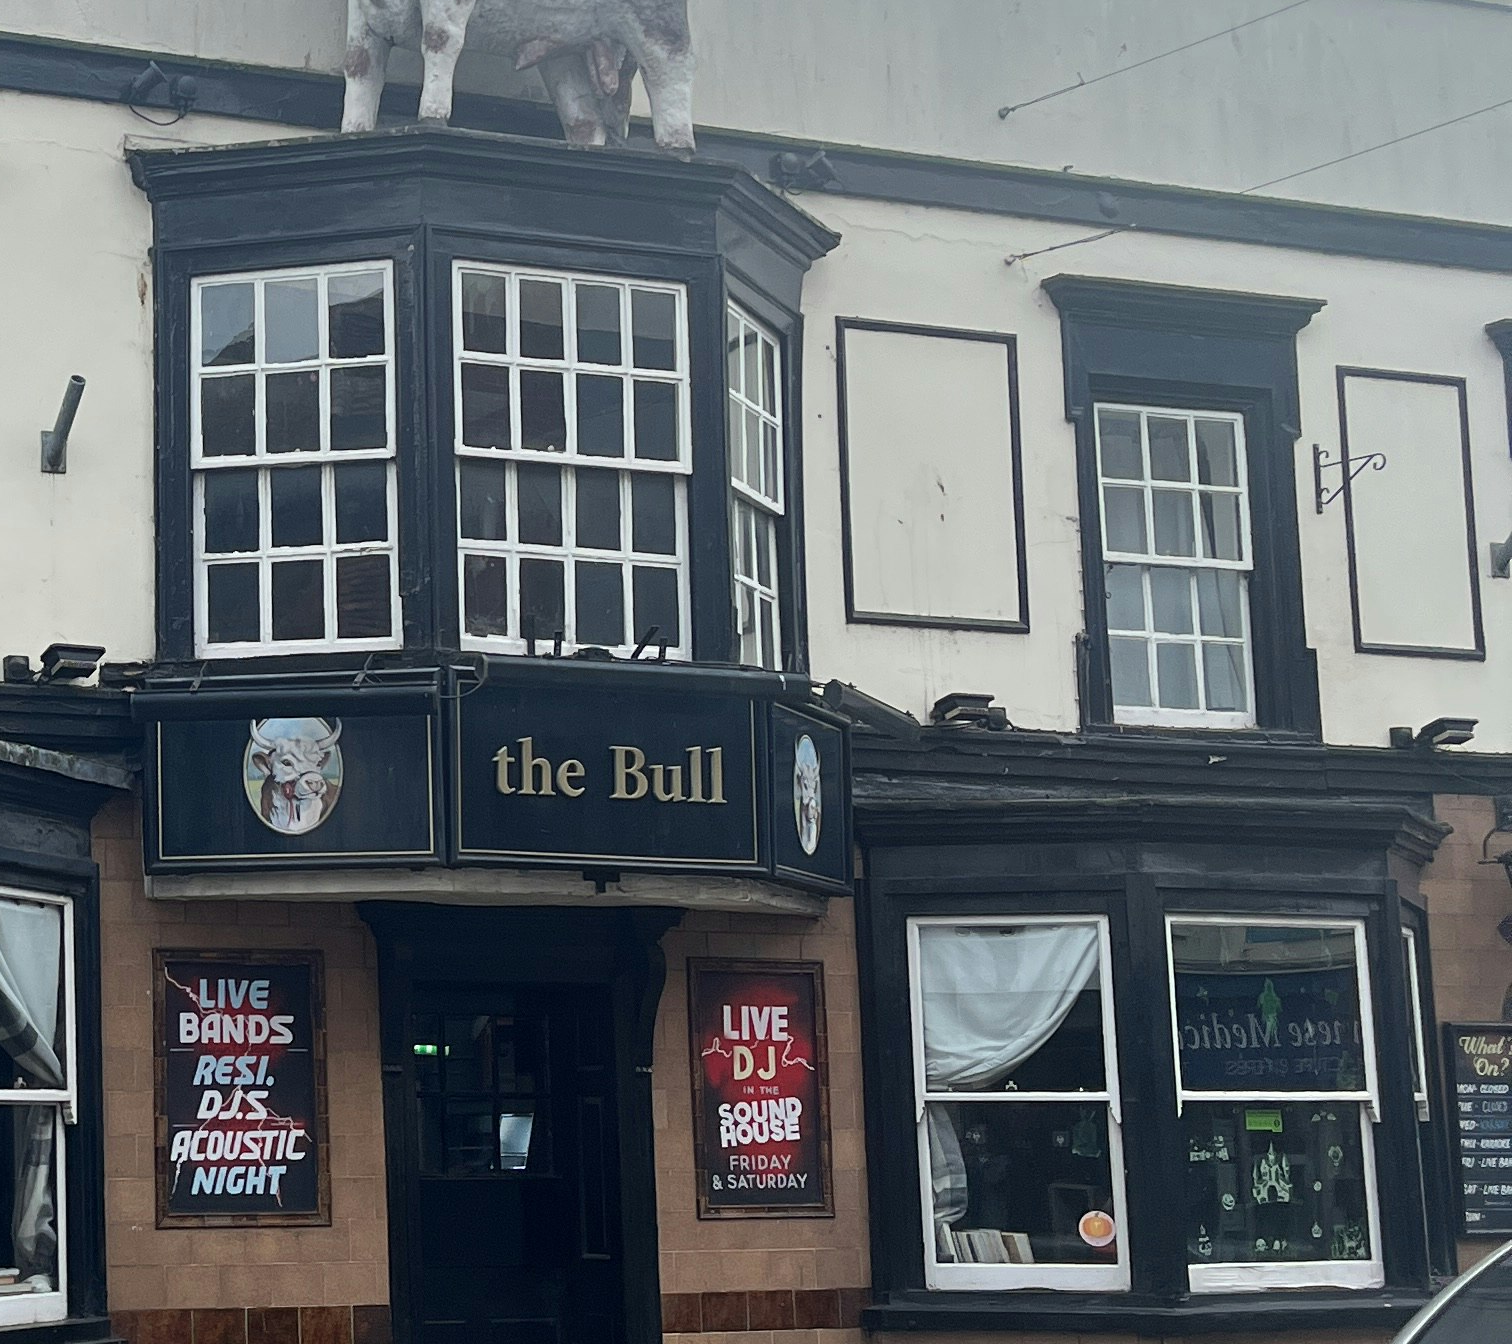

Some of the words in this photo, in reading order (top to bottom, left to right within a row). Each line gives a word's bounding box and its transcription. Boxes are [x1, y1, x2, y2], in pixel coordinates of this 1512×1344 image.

[492, 736, 586, 797] the
[609, 744, 727, 805] Bull
[199, 978, 270, 1009] LIVE
[179, 1012, 294, 1045] BANDS
[723, 1004, 789, 1042] LIVE
[193, 1055, 275, 1086] RESI.
[733, 1045, 777, 1081] DJ
[1473, 1056, 1509, 1076] On?
[743, 1086, 755, 1094] IN
[759, 1086, 779, 1095] THE
[718, 1097, 802, 1127] SOUND
[170, 1130, 306, 1162] ACOUSTIC
[719, 1121, 801, 1148] HOUSE
[729, 1154, 792, 1171] FRIDAY
[191, 1165, 287, 1195] NIGHT
[712, 1174, 723, 1191] &
[727, 1173, 808, 1189] SATURDAY
